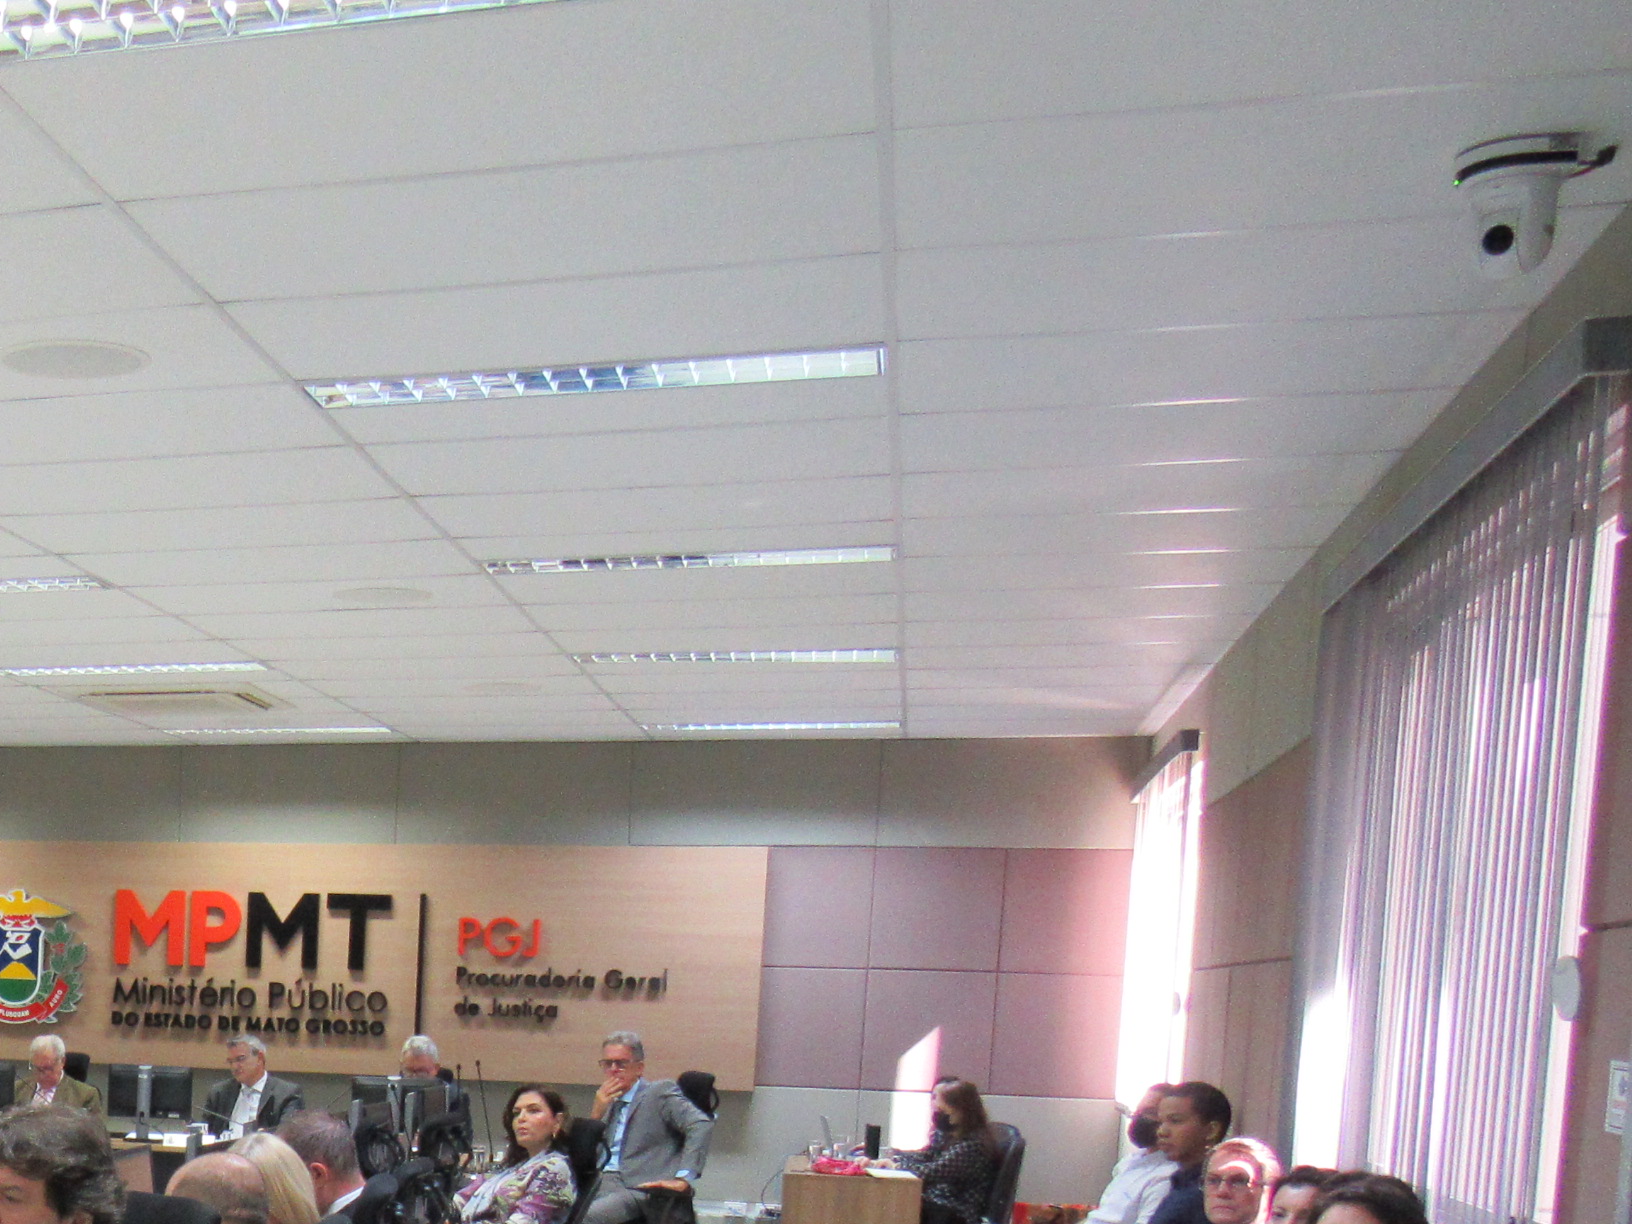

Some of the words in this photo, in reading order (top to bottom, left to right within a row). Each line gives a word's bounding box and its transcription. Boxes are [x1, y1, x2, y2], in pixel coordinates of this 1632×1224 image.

[113, 888, 393, 971] MPMT
[457, 916, 543, 958] PGJ
[112, 976, 257, 1010] Ministério
[268, 977, 388, 1013] Público
[455, 966, 596, 990] Procuradoria
[604, 968, 668, 992] Geral
[111, 1010, 140, 1027] DO
[144, 1011, 213, 1030] ESTADO
[218, 1014, 240, 1032] DE
[245, 1015, 300, 1034] MATO
[305, 1017, 386, 1036] GROSSO
[454, 995, 480, 1017] de
[488, 997, 559, 1023] Justiça
